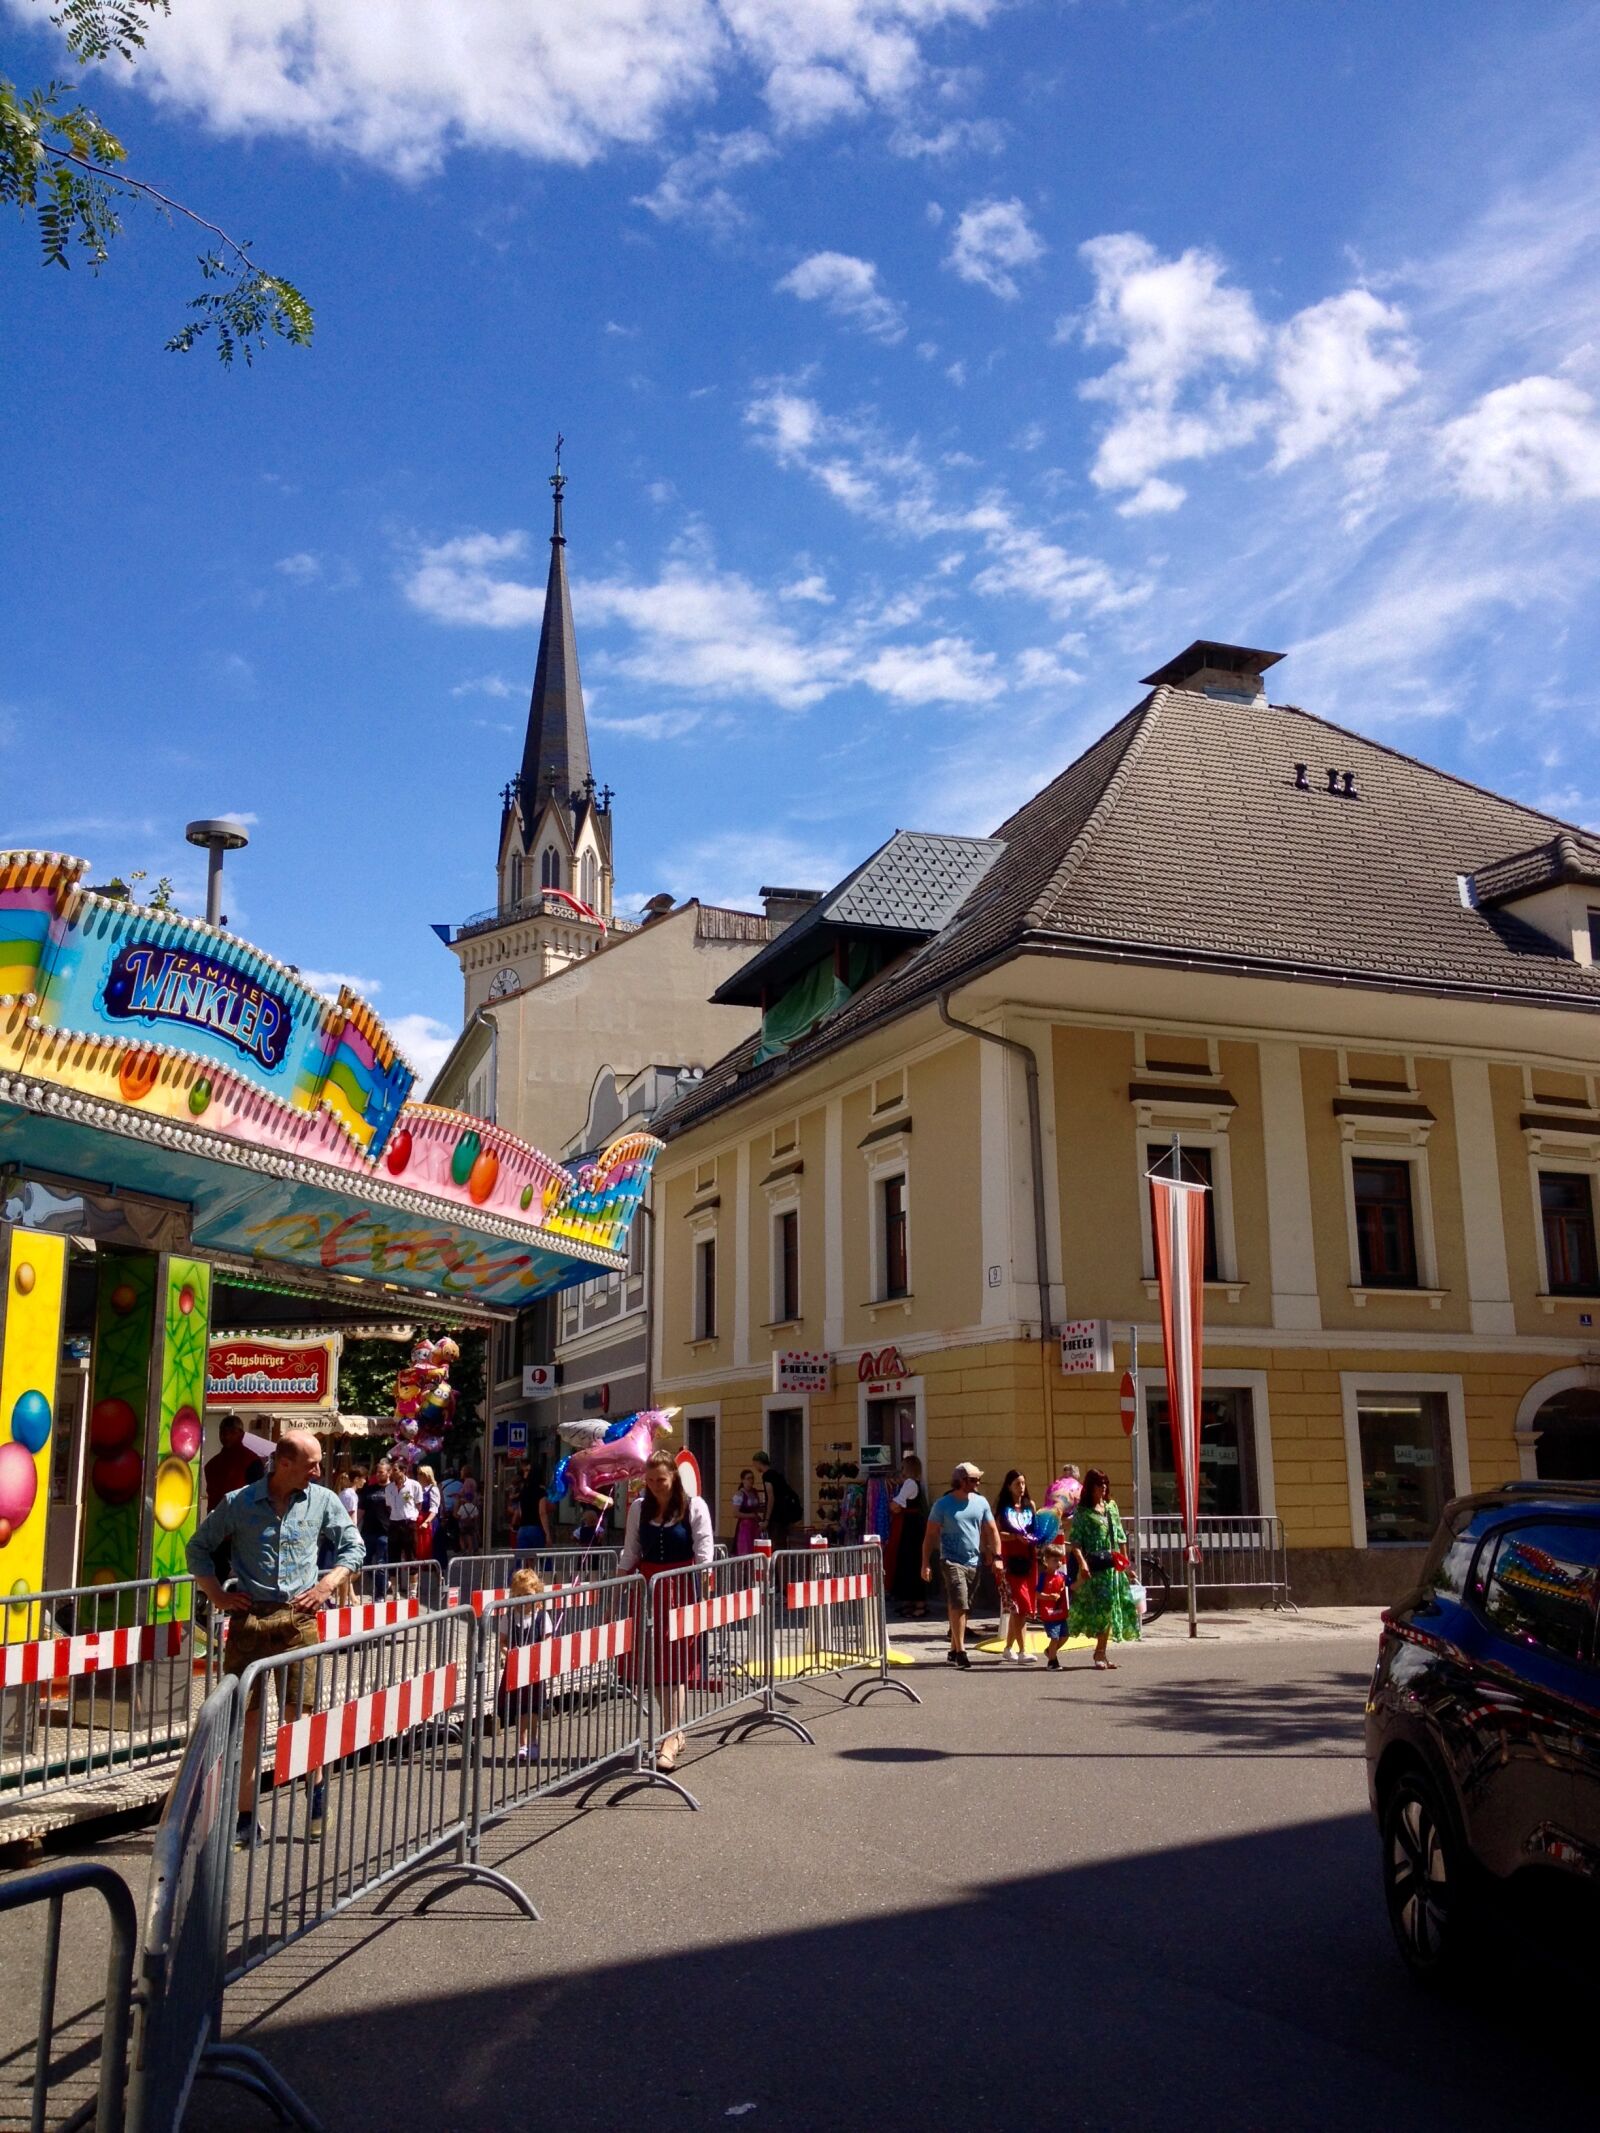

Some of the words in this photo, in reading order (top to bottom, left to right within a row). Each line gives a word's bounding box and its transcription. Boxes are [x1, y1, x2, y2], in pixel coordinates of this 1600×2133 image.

[178, 959, 258, 1002] FAMILIE
[126, 950, 280, 1063] WINKLER
[225, 1353, 285, 1368] Augsburger
[288, 1419, 337, 1430] Magenbrot
[1396, 1449, 1413, 1458] SALE
